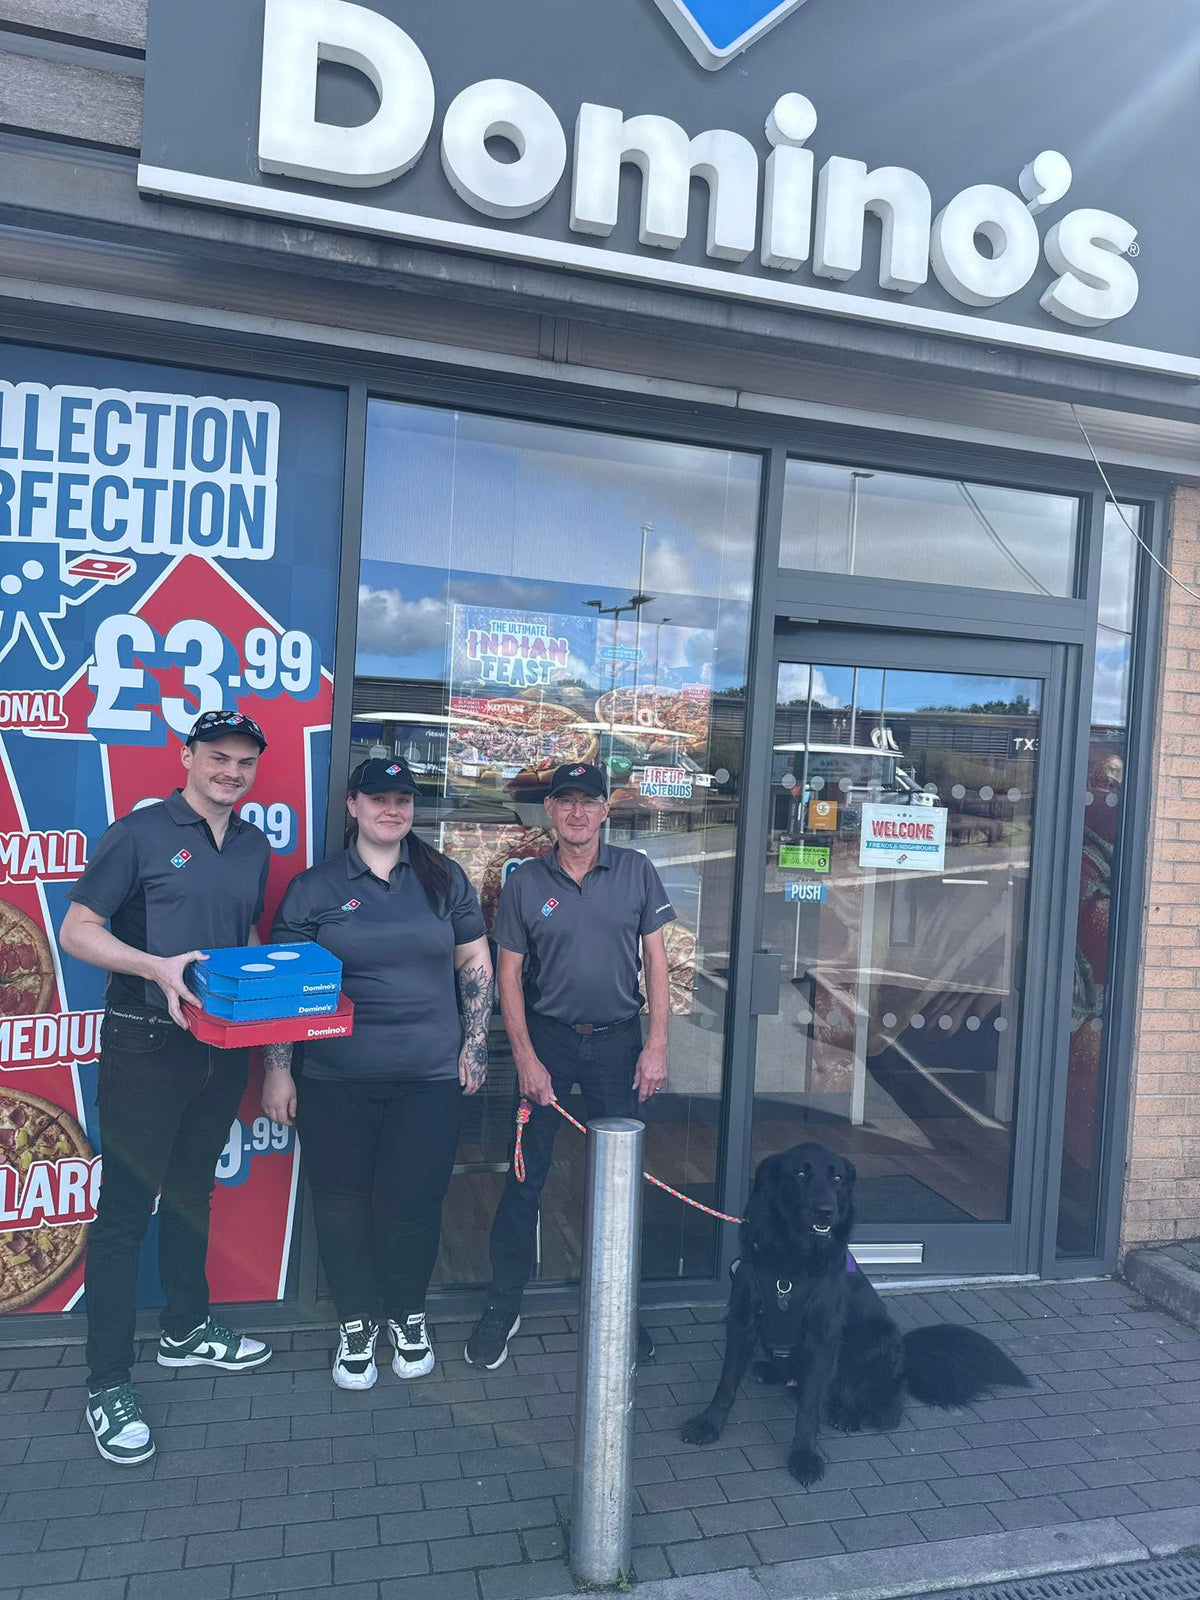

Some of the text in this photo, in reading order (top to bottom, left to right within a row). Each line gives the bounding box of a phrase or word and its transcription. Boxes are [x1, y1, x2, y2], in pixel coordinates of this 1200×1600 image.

[257, 0, 1139, 328] Domino's
[490, 621, 546, 637] THE ULTIMATE
[467, 630, 569, 667] INDIAN
[480, 655, 556, 686] FEAST
[644, 768, 684, 784] FIRE UP
[640, 782, 691, 797] TASTEBUDS
[872, 820, 934, 841] WELCOME
[791, 884, 822, 900] PUSH
[303, 982, 336, 992] Domino's
[298, 1003, 332, 1013] Domino's
[307, 1025, 347, 1037] Domino's
